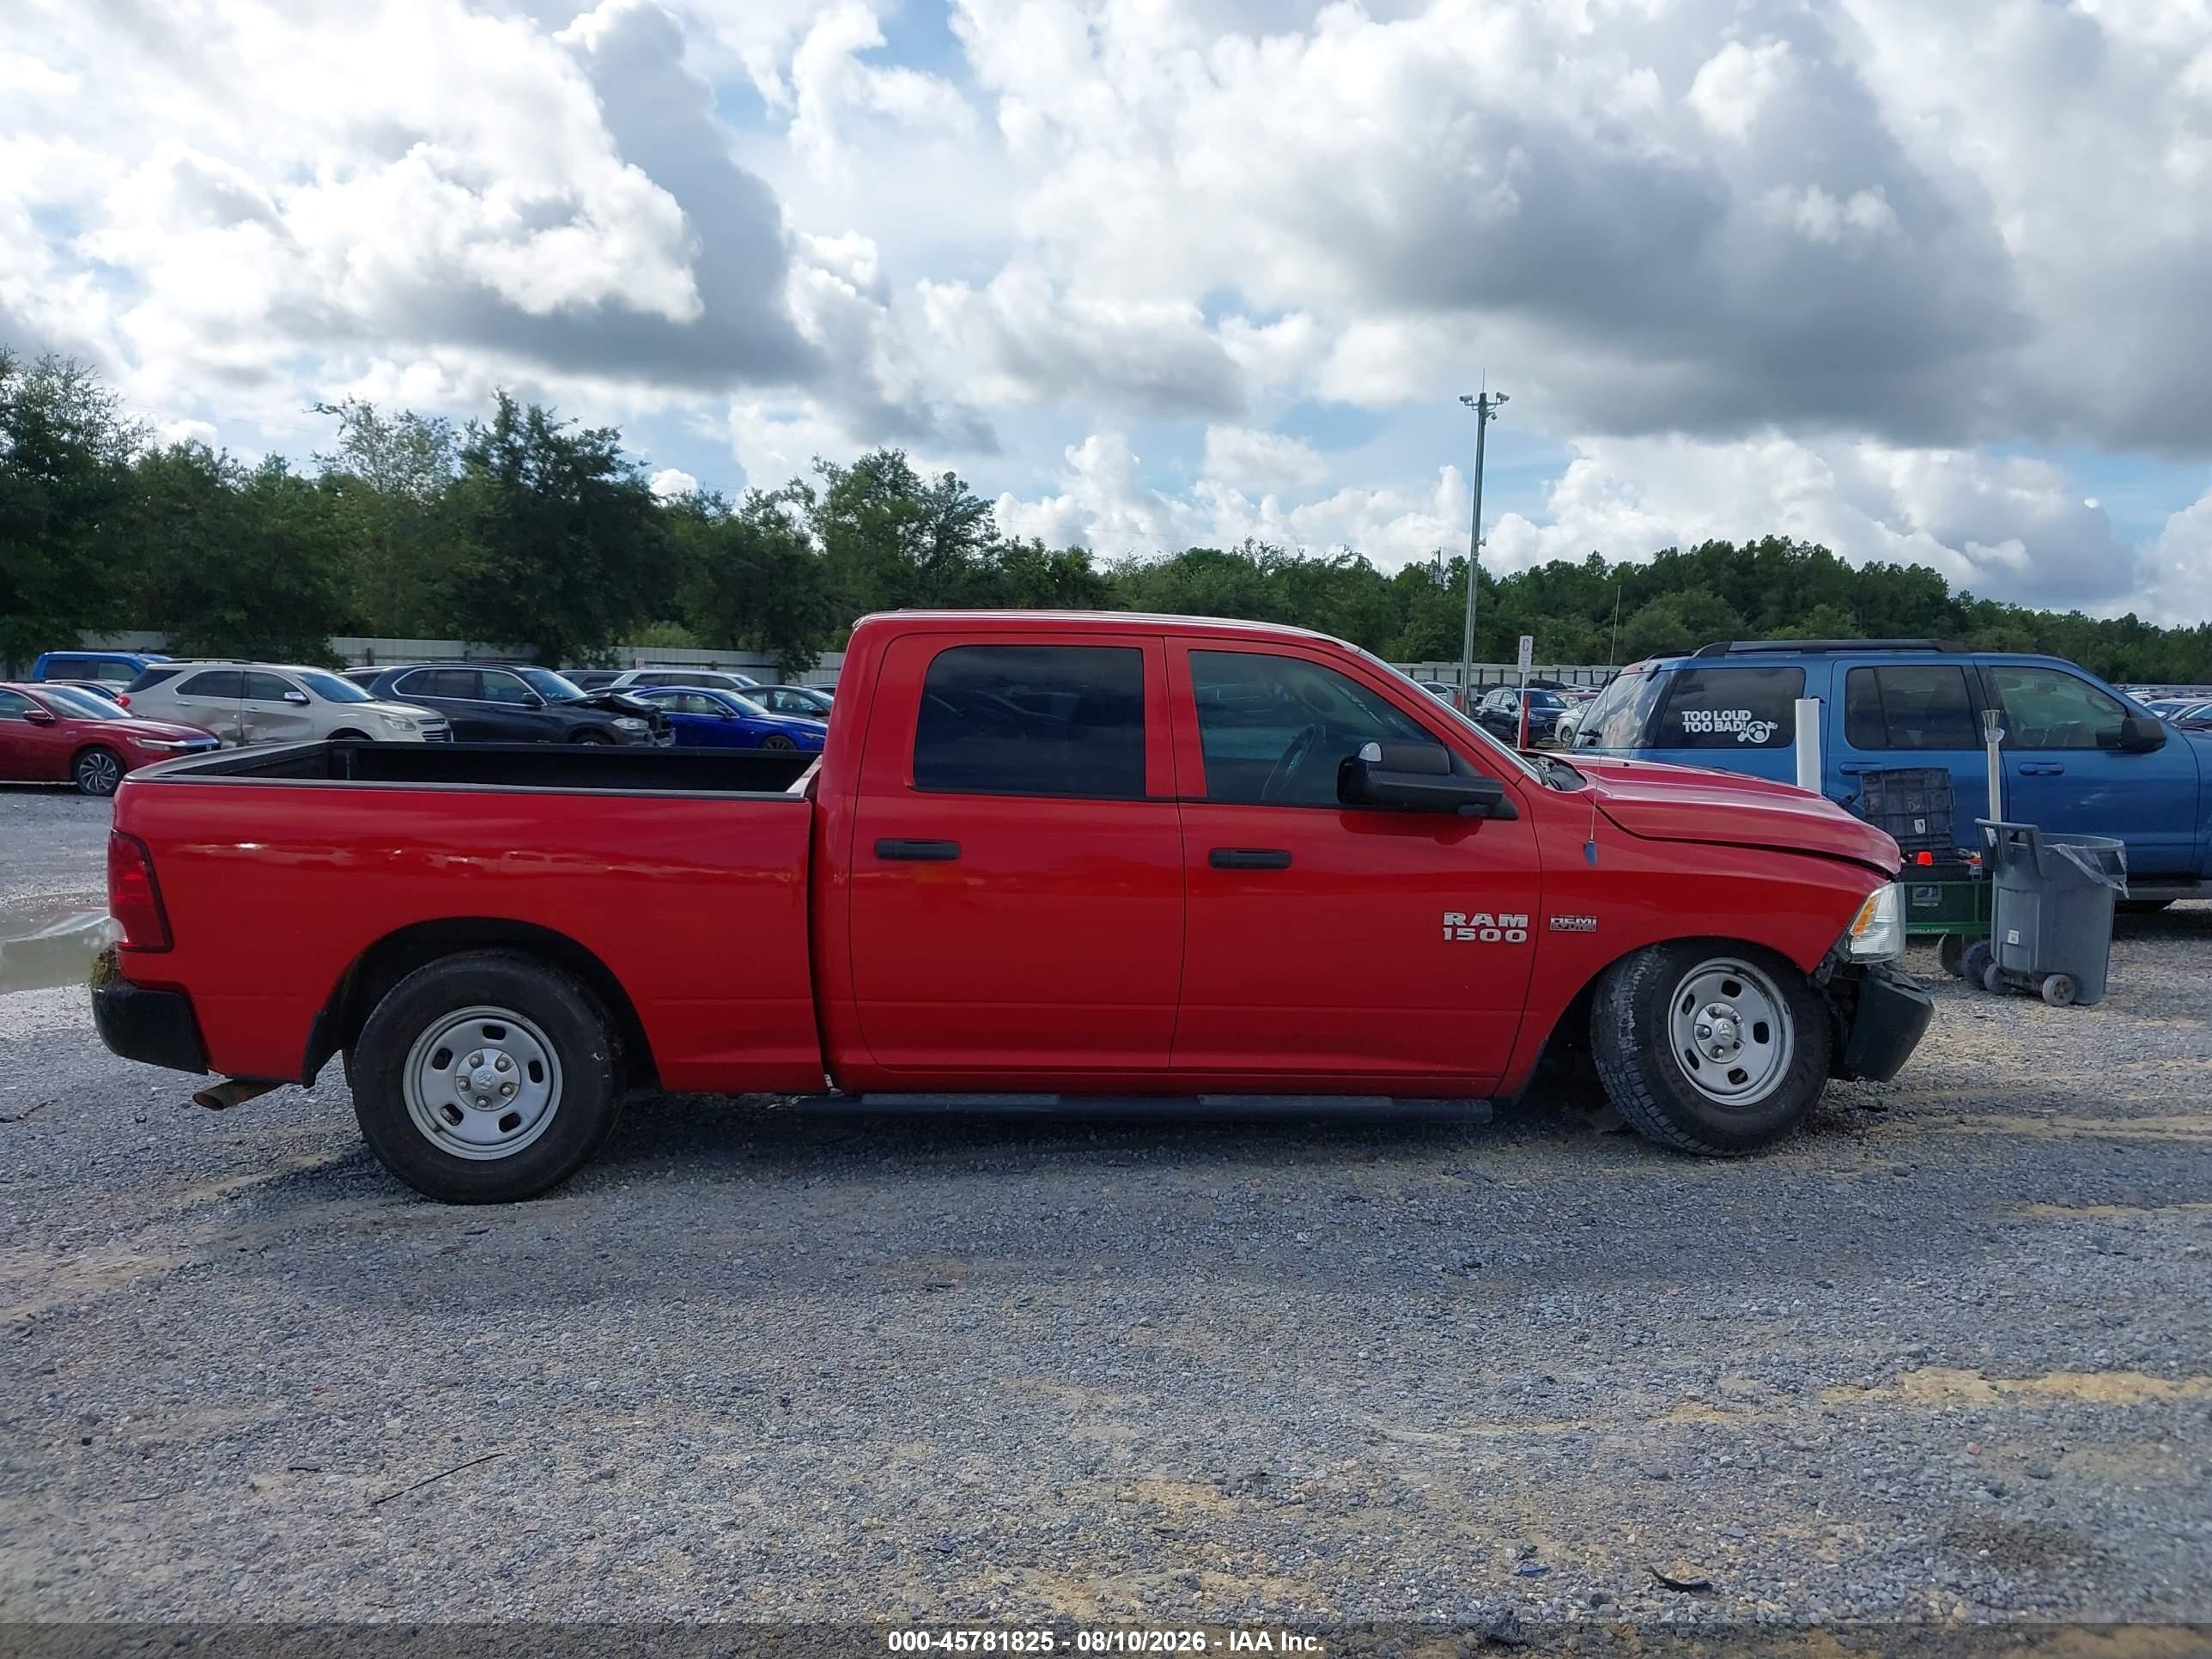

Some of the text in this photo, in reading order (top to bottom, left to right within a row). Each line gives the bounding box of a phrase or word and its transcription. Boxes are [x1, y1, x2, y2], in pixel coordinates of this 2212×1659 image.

[1522, 639, 1529, 652] C
[1681, 710, 1752, 721] TOO LOUD
[1682, 720, 1747, 732] TOO BAD!
[1443, 912, 1528, 927] RAM
[1551, 914, 1597, 924] HEMI
[1443, 927, 1528, 942] 1500
